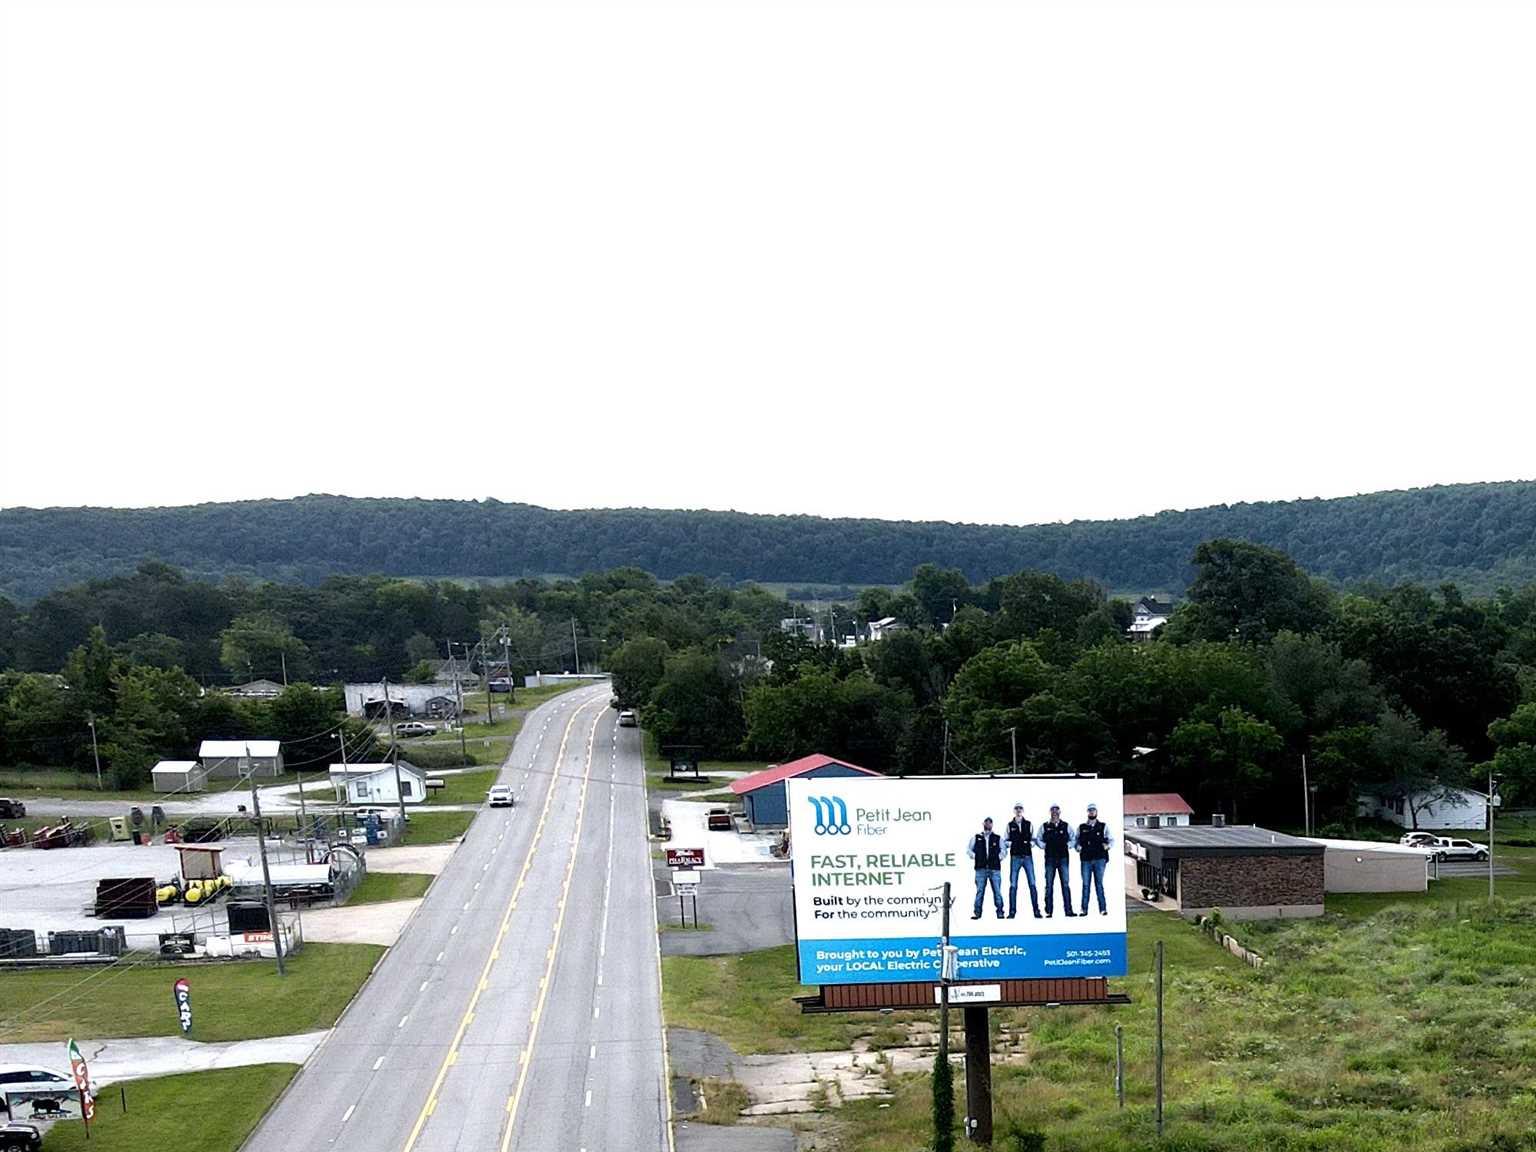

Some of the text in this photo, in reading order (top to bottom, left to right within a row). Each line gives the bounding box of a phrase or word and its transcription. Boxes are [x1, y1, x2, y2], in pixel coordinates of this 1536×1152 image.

[856, 807, 932, 822] Petit Jean
[857, 823, 888, 836] Fiber
[811, 853, 956, 870] FAST, RELIABLE
[812, 871, 905, 886] INTERNET
[813, 895, 956, 907] Built by the communy
[814, 907, 930, 920] For the community
[816, 950, 865, 962] Brought
[867, 949, 880, 959] to
[882, 949, 904, 961] you
[906, 948, 919, 959] by
[981, 945, 1027, 956] Electric,
[816, 958, 1000, 973] your LOCAL Electric Cperative
